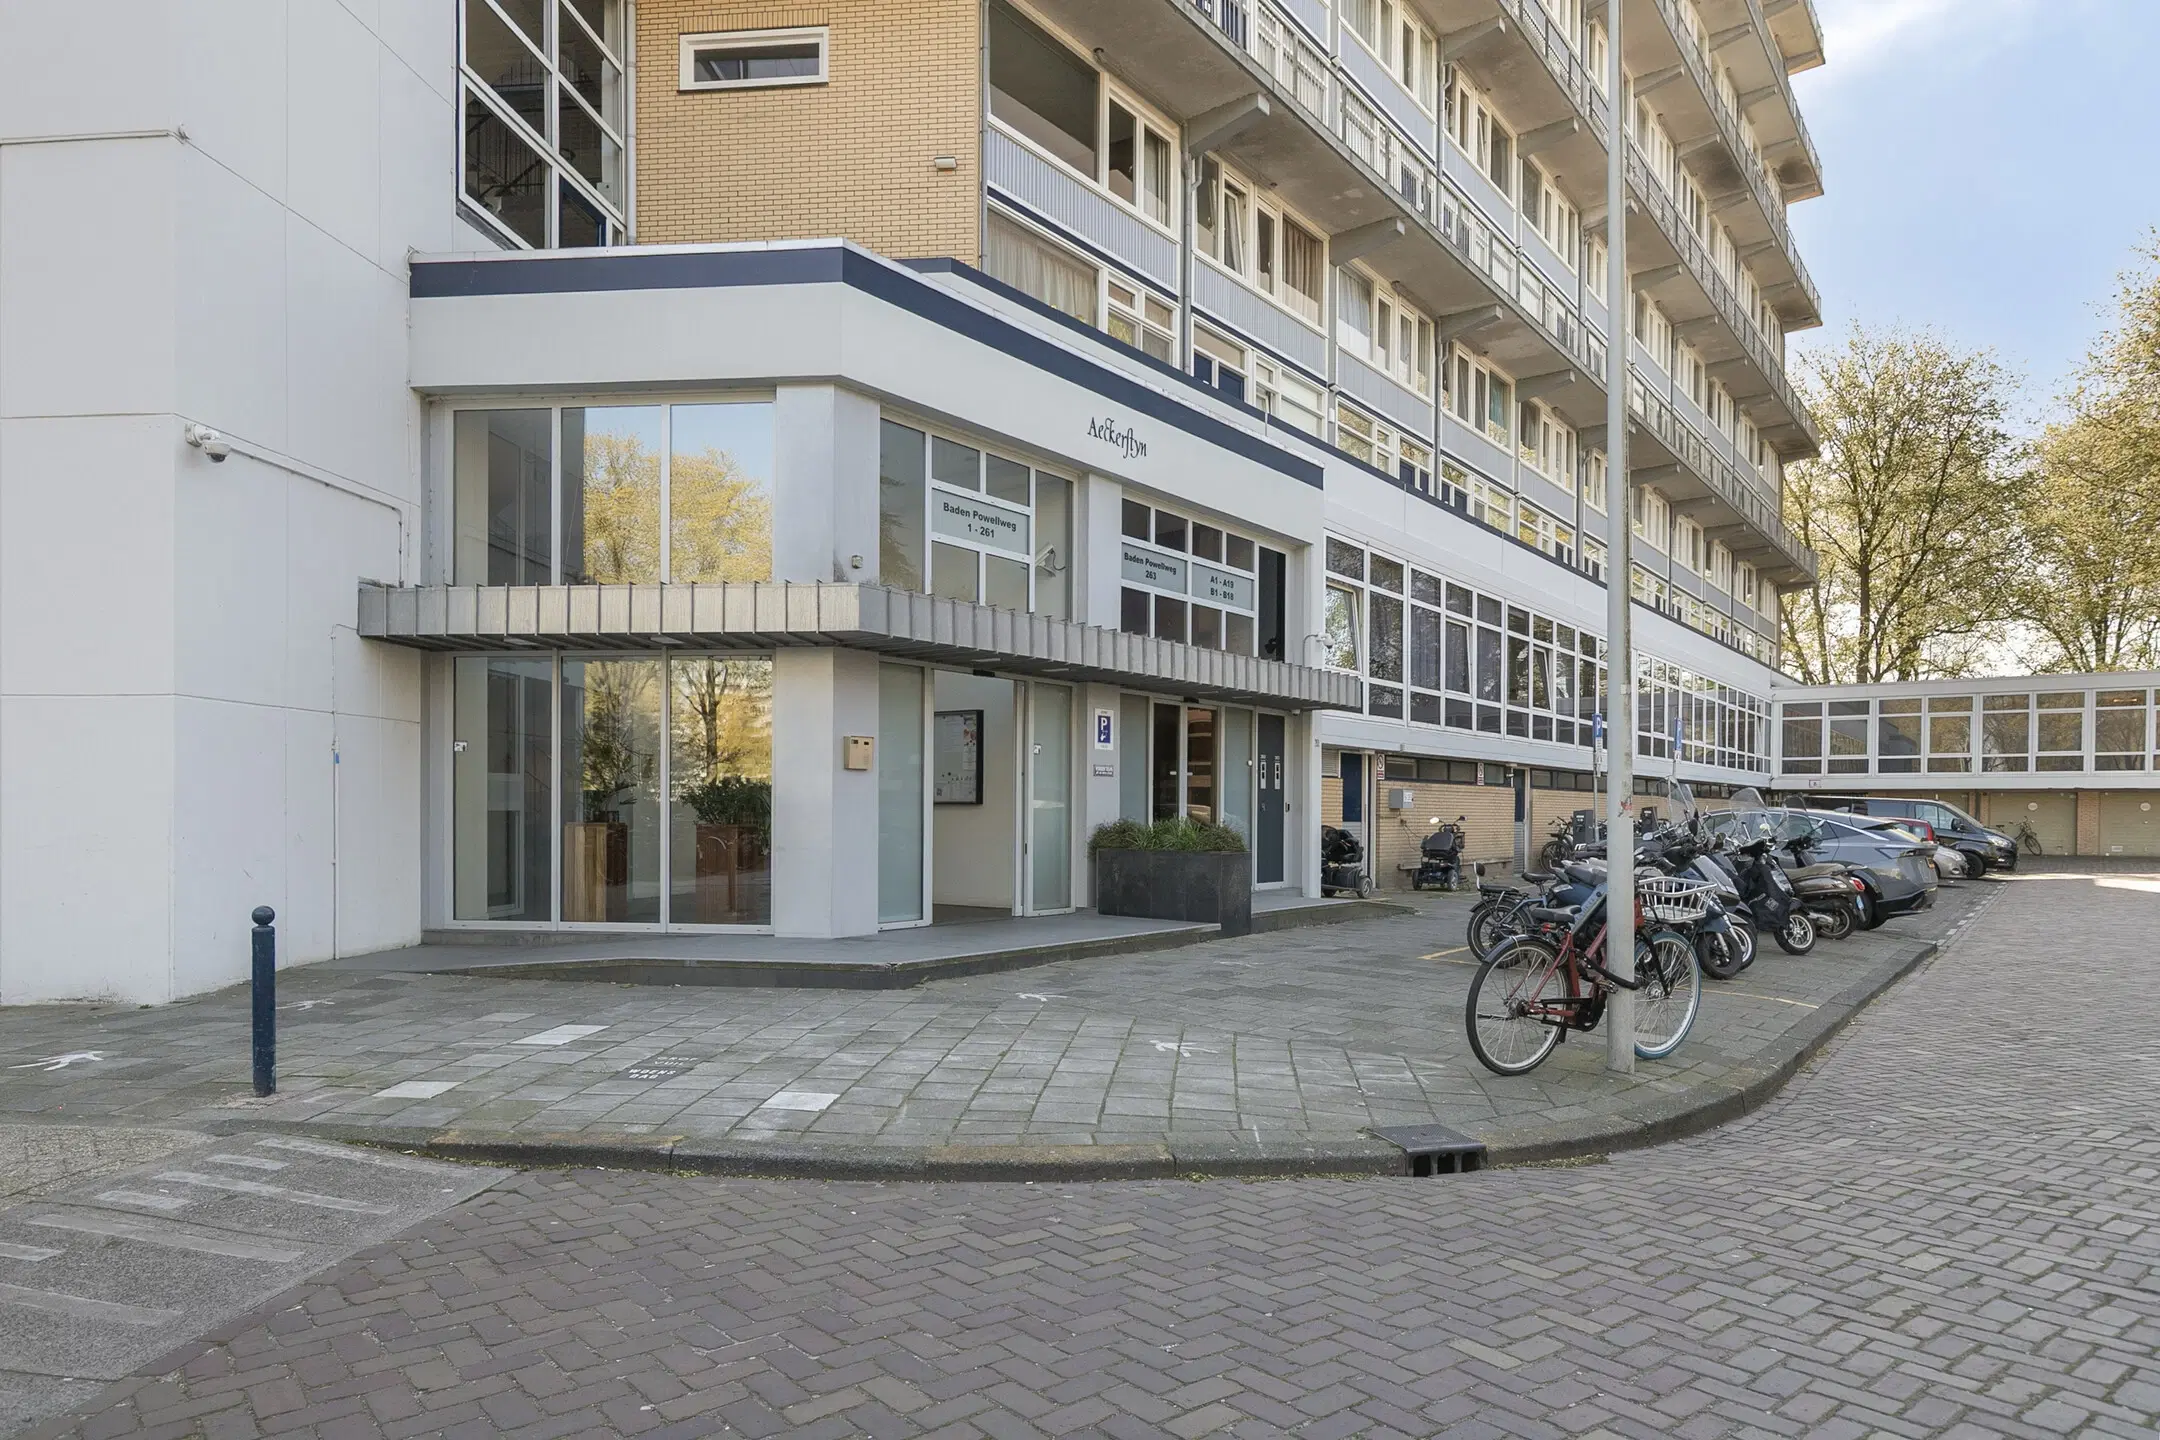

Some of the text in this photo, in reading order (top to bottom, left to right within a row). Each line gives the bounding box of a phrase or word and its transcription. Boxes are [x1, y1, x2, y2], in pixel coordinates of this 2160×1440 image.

[943, 502, 1017, 532] Baden Powellweg
[967, 524, 972, 533] 1
[980, 526, 995, 538] 261
[1124, 552, 1177, 576] Baden Powellweg
[1210, 576, 1219, 585] A1
[1210, 587, 1219, 597] B1
[1100, 717, 1108, 731] P
